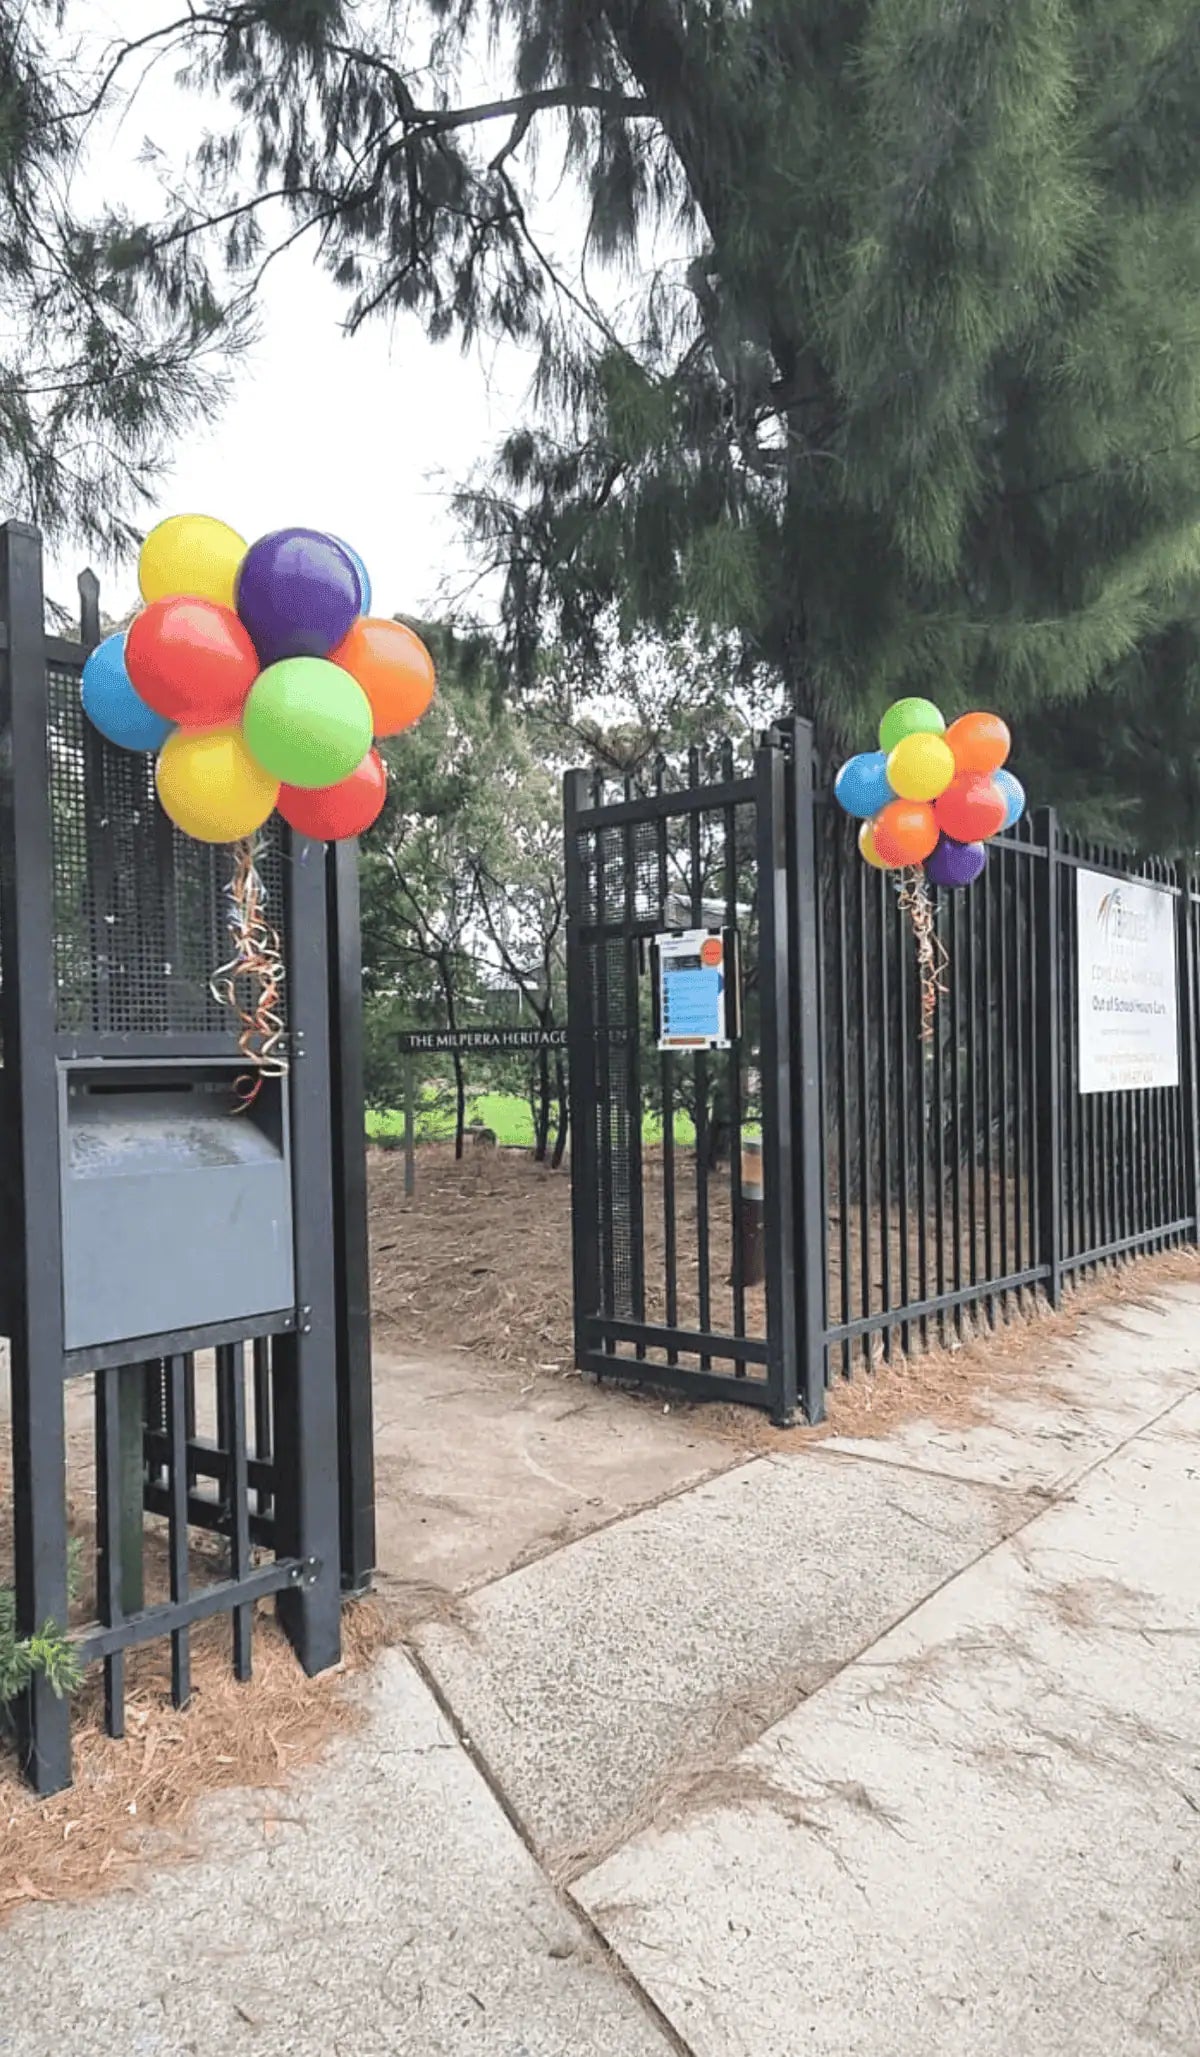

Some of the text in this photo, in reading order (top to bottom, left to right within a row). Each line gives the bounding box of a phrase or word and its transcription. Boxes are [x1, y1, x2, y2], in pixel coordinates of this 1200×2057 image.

[409, 1035, 433, 1048] THE
[436, 1032, 499, 1047] MILPERRA
[503, 1030, 567, 1044] HERITAGE
